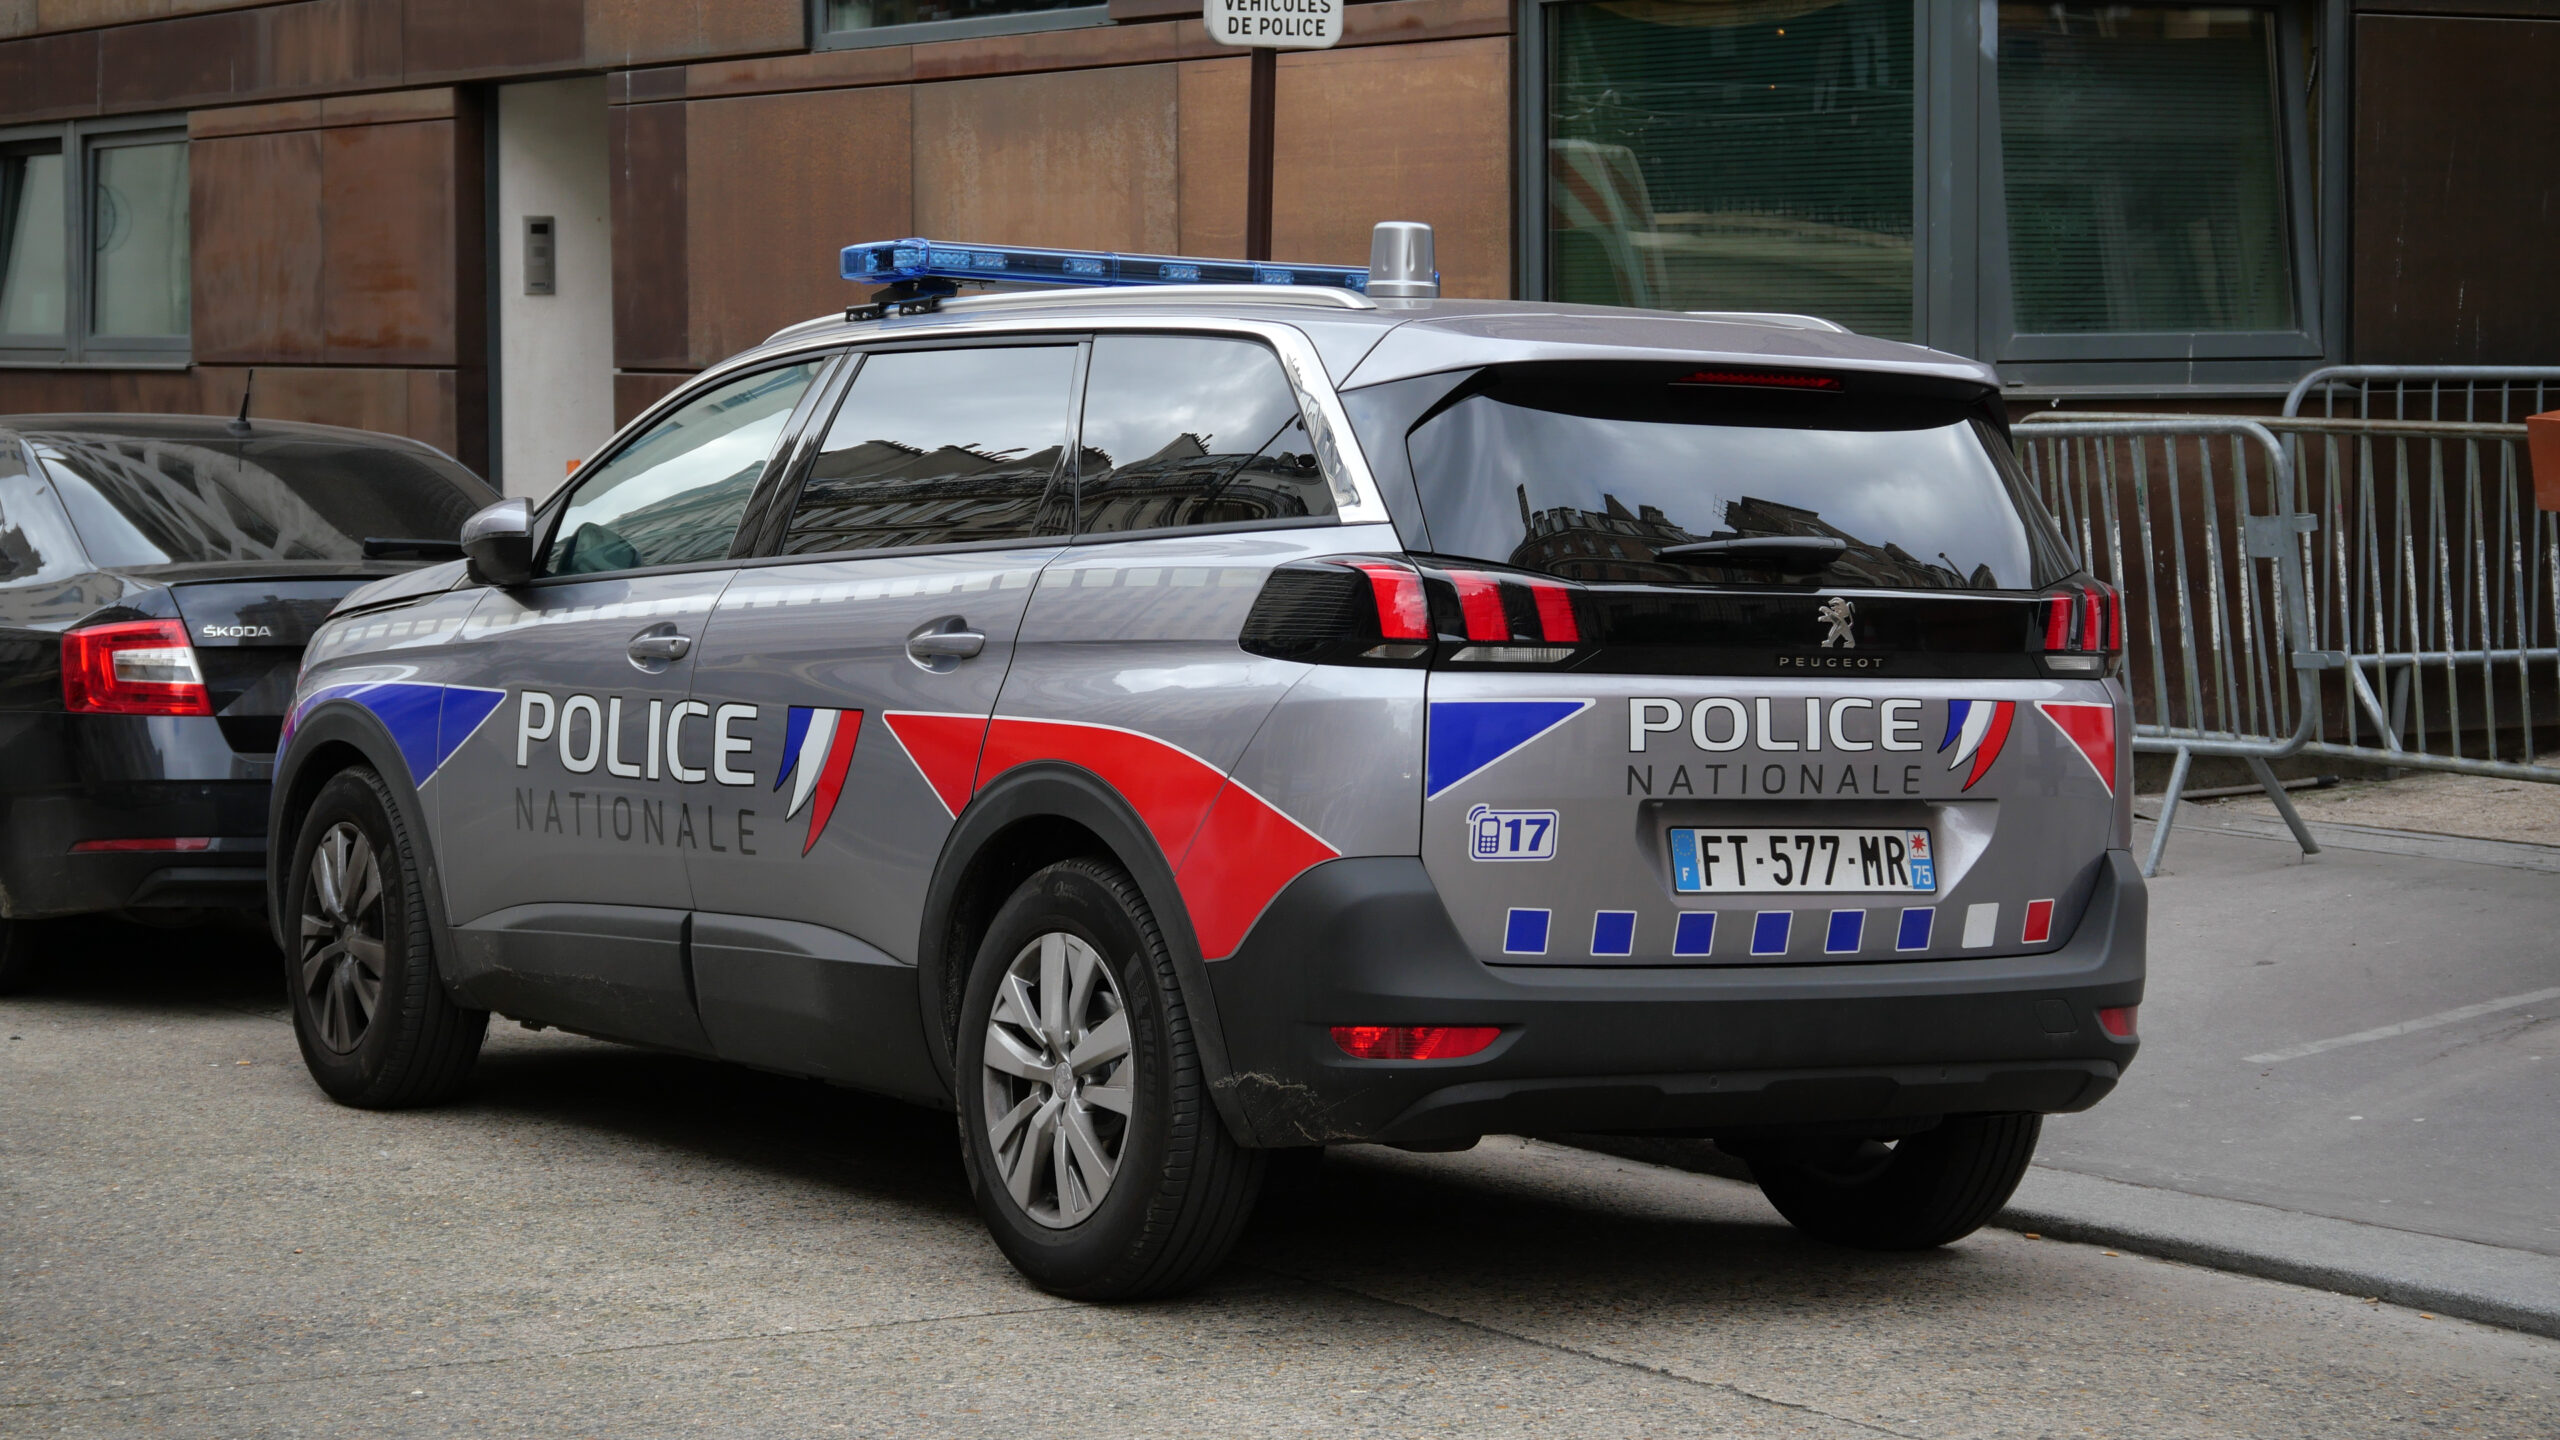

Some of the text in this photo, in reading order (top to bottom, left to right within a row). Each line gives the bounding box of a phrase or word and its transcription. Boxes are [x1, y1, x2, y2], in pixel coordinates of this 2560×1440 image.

[1228, 16, 1326, 37] DE POLICE
[203, 624, 272, 638] ŠKODA
[1779, 657, 1883, 668] PEUGEOT
[516, 690, 758, 787] POLICE
[1628, 697, 1922, 752] POLICE
[1627, 764, 1922, 795] NATIONALE
[516, 787, 757, 856] NATIONALE
[1505, 819, 1551, 852] 17
[1682, 867, 1690, 882] F
[1701, 835, 1909, 886] FT-577-MR
[1912, 865, 1932, 885] 75
